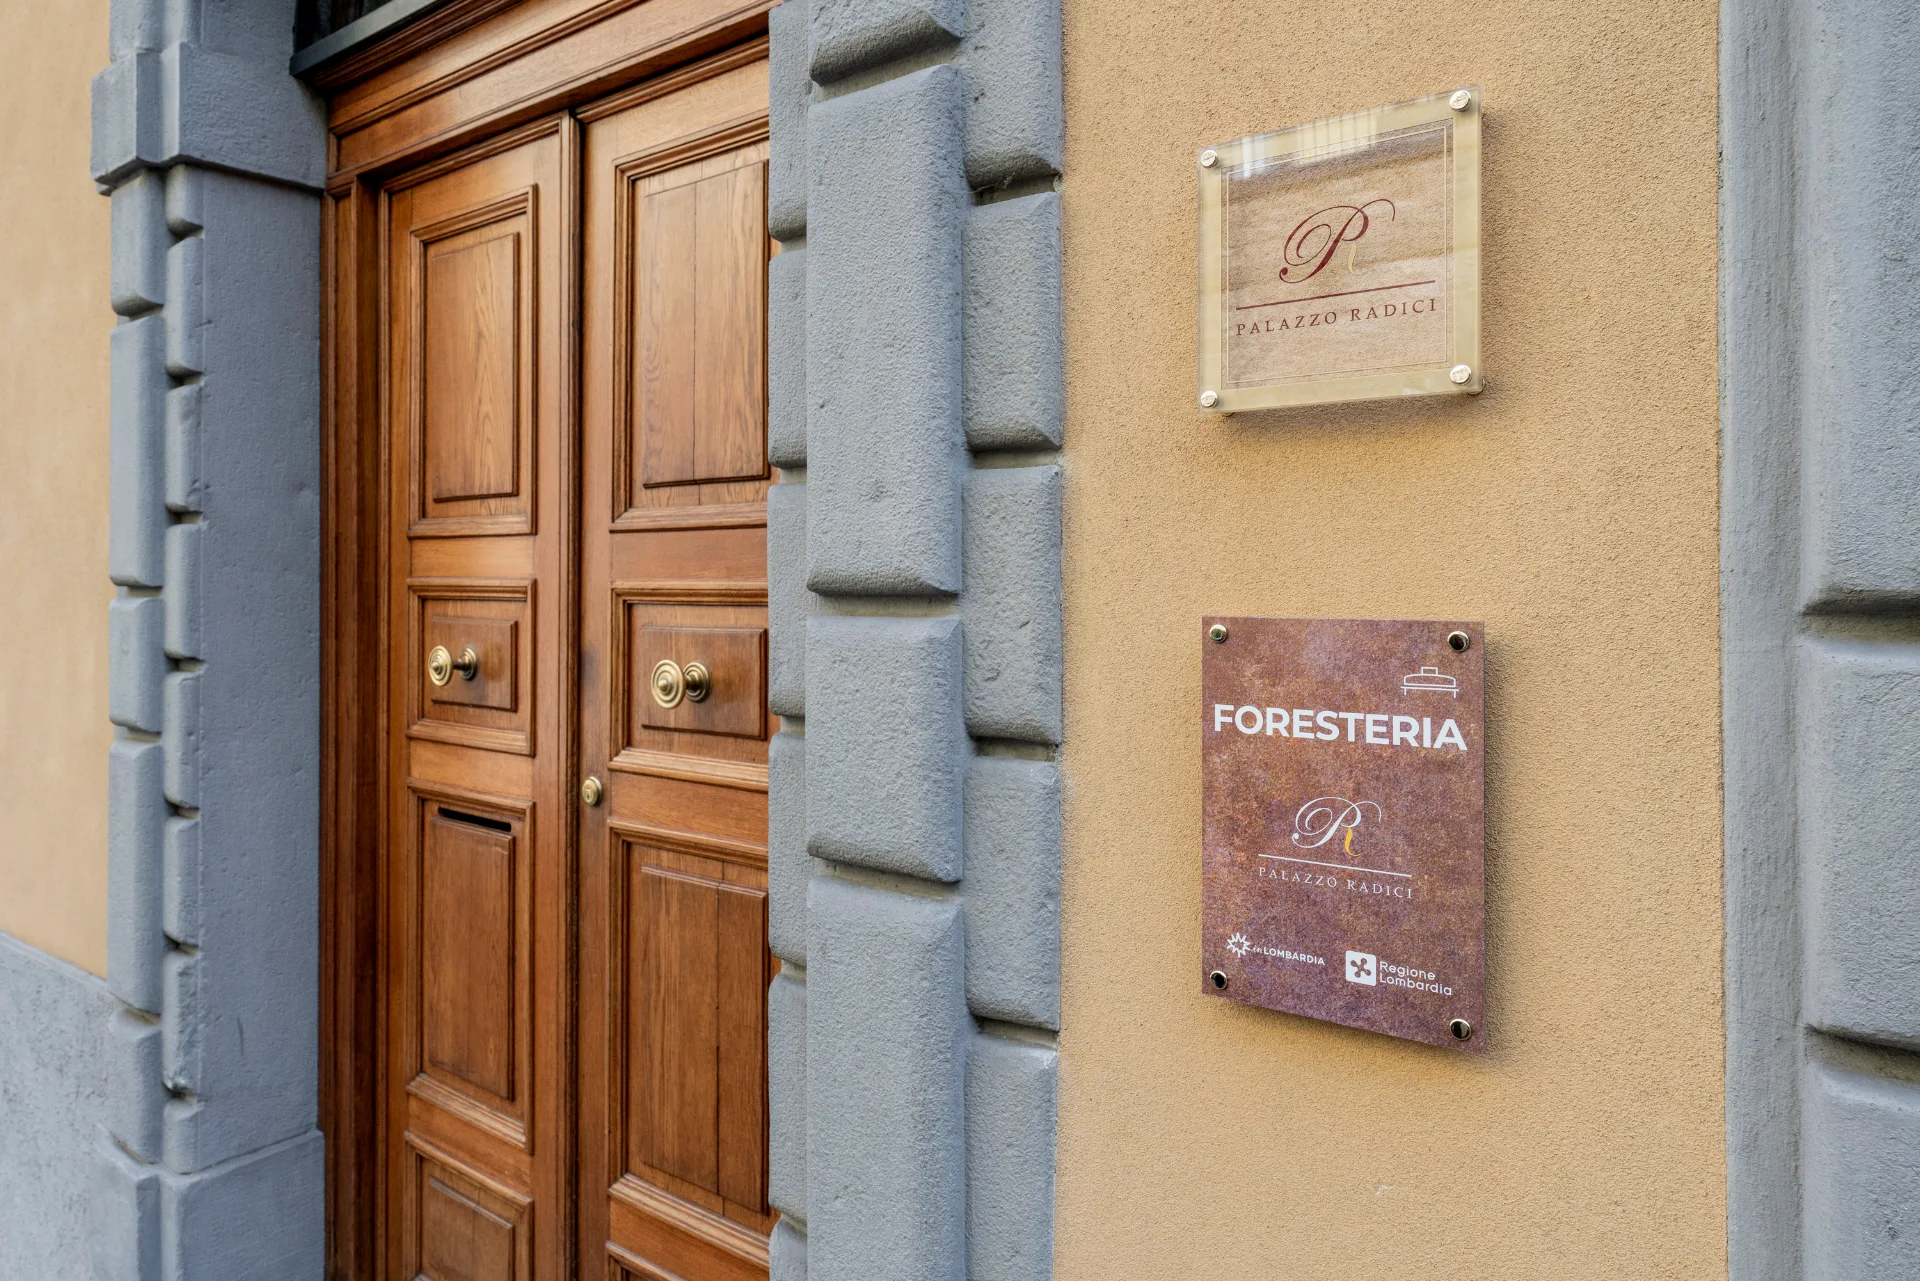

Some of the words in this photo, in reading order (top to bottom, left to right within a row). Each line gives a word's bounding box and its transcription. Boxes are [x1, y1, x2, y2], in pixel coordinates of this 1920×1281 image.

[1236, 311, 1338, 337] PALAZZO
[1350, 298, 1437, 322] RADICI
[1213, 703, 1468, 751] FORESTERIA
[1258, 866, 1338, 888] PALAZZO
[1346, 879, 1413, 899] RADICI
[1379, 960, 1436, 981] Regione
[1379, 975, 1453, 996] Lombardia
